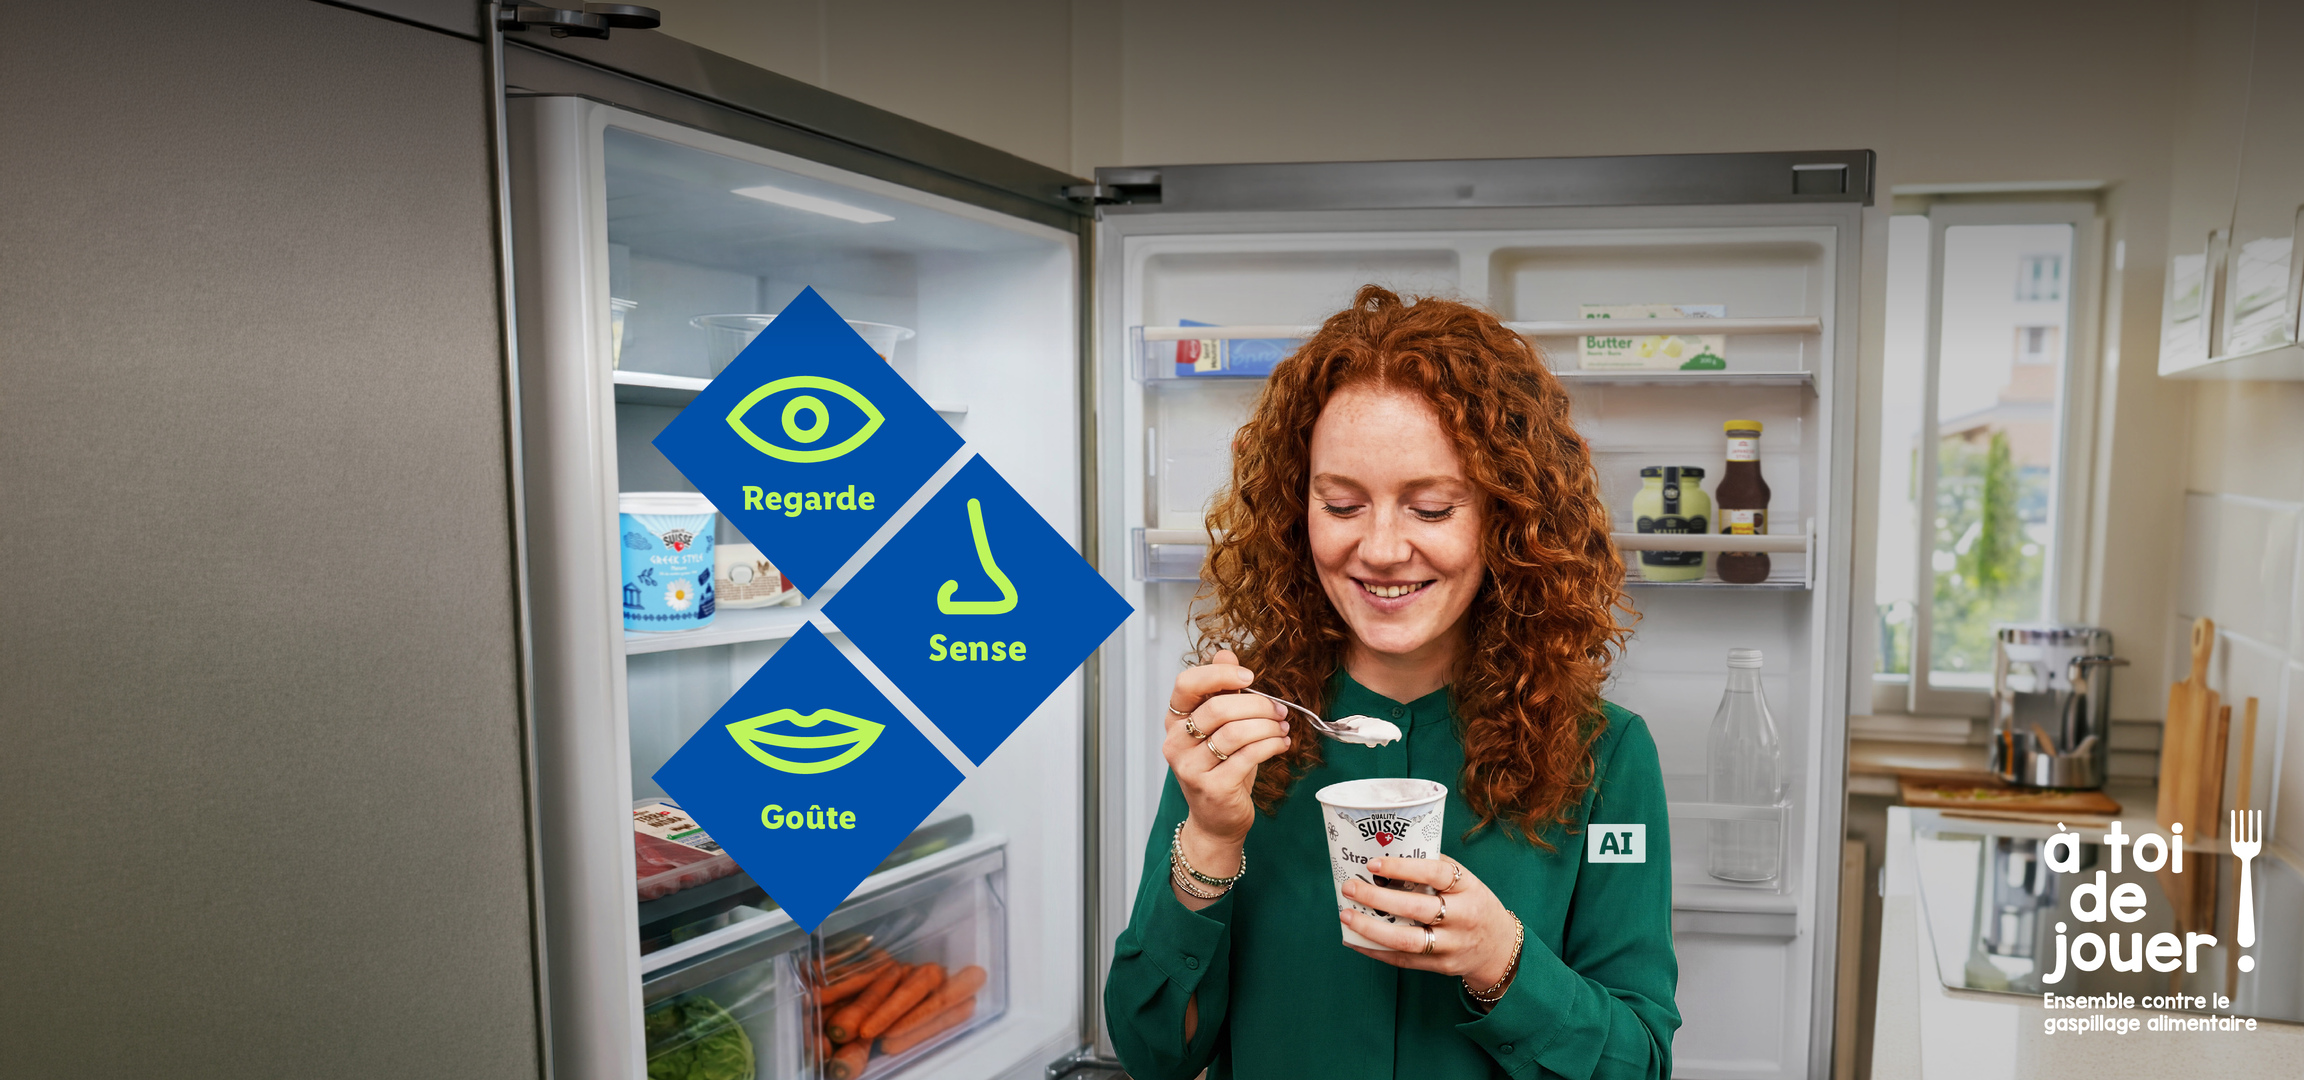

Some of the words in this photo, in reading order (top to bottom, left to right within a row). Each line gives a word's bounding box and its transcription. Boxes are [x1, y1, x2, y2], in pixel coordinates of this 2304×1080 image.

[1586, 336, 1633, 349] Butter
[663, 533, 693, 546] SUISSE
[650, 554, 680, 565] GREEK
[682, 552, 704, 564] STYLE
[1371, 812, 1396, 820] QUALITÉ
[1358, 820, 1410, 838] SUISSE
